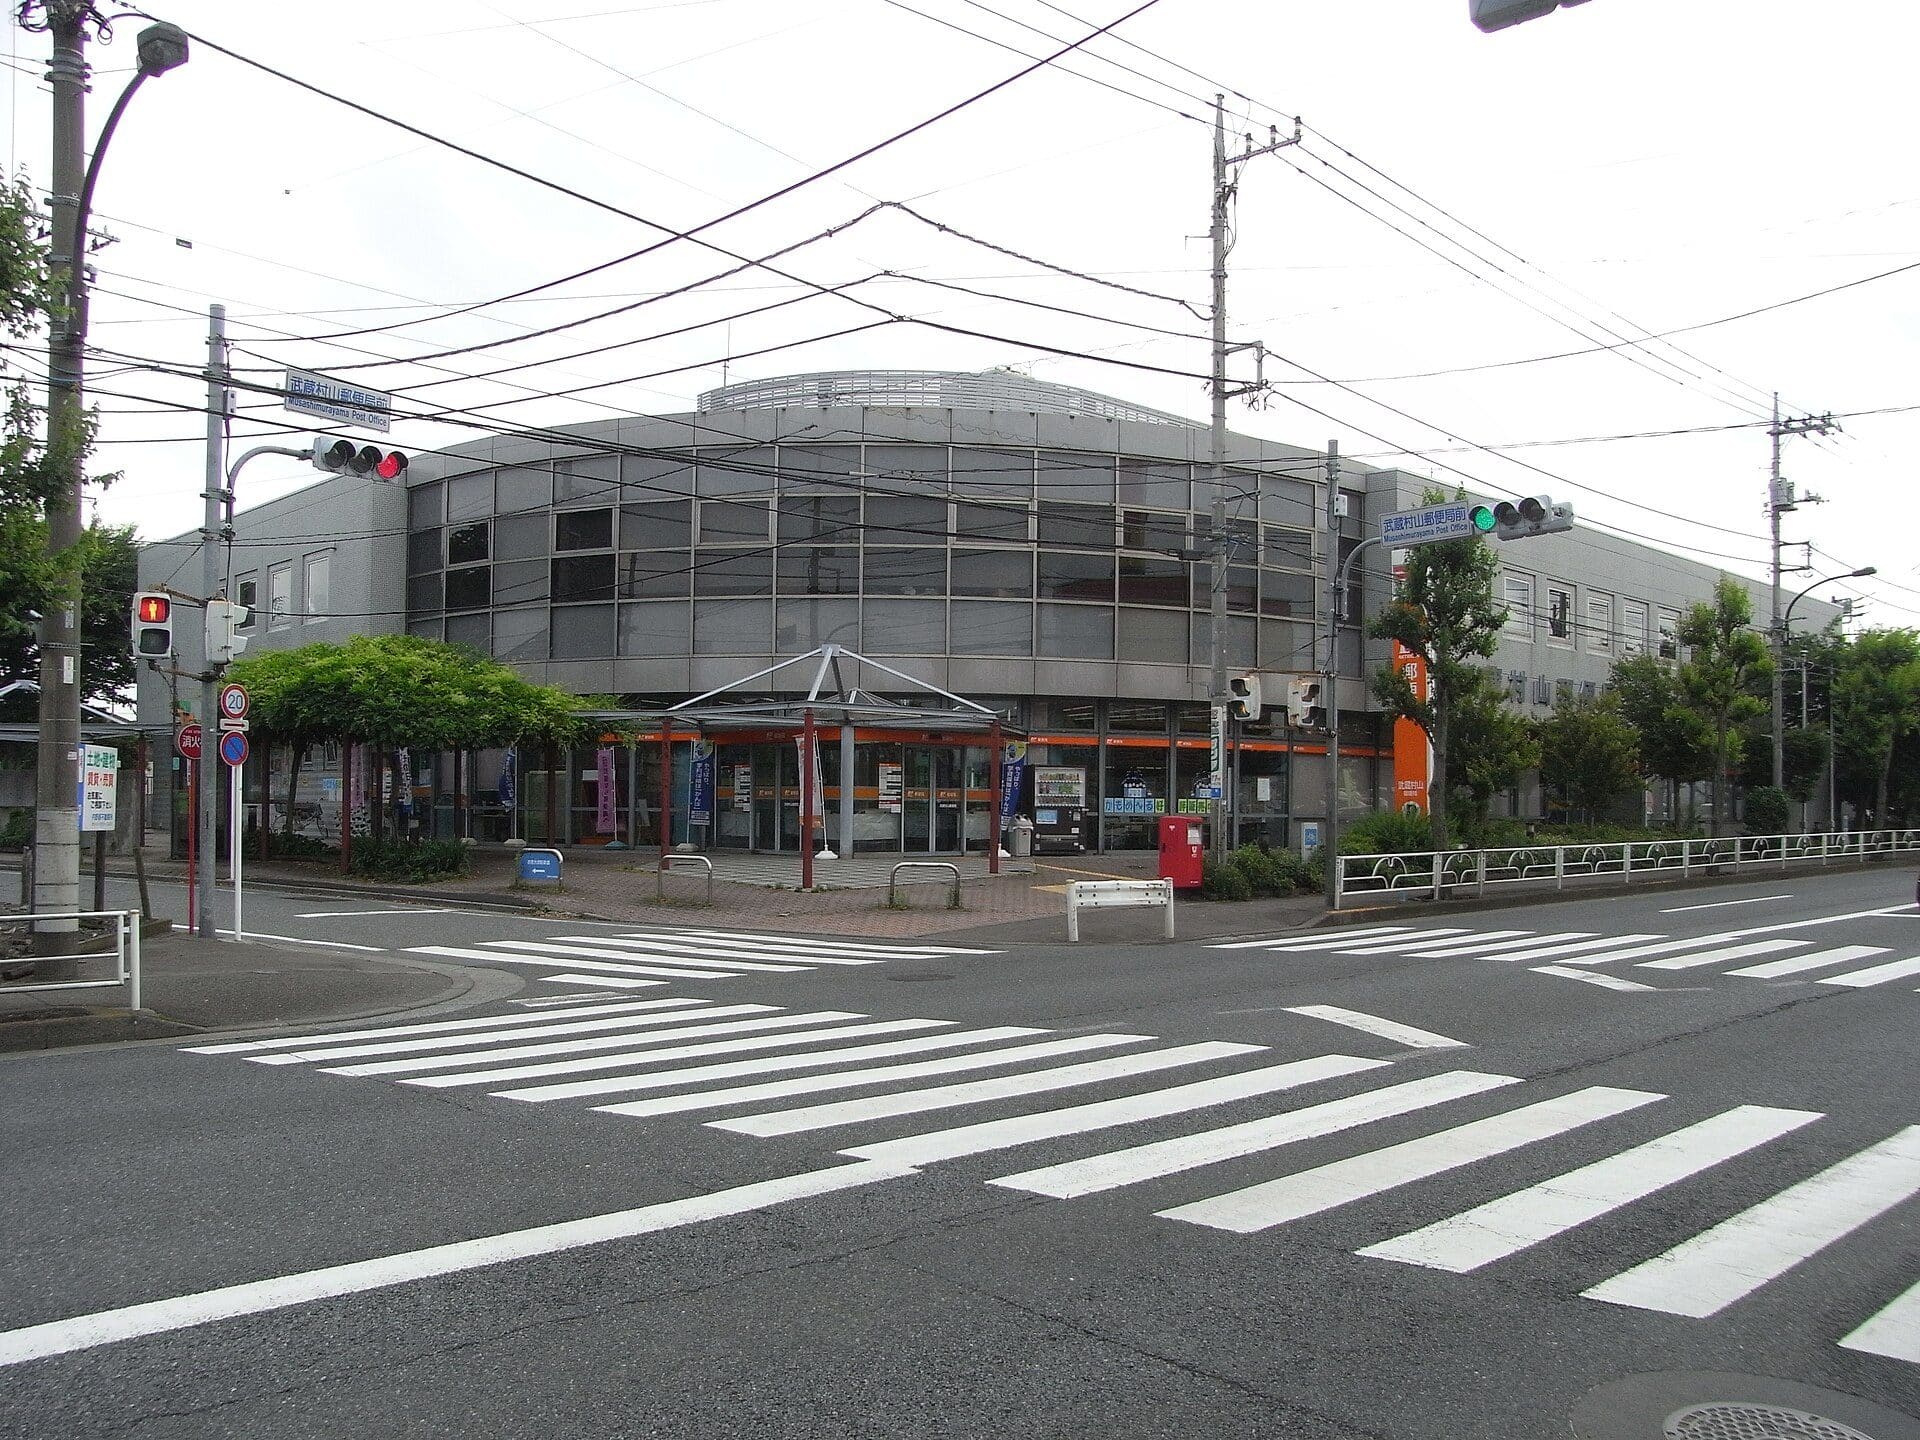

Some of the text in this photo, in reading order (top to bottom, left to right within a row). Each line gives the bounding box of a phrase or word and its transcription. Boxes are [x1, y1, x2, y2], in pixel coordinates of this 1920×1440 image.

[288, 396, 387, 427] Musashimurayama Post Office
[1383, 507, 1466, 533] 武蔵村山郵便局前
[1383, 523, 1468, 542] Musashimurayama Post Office
[228, 694, 244, 709] 20
[182, 735, 202, 748] 消火
